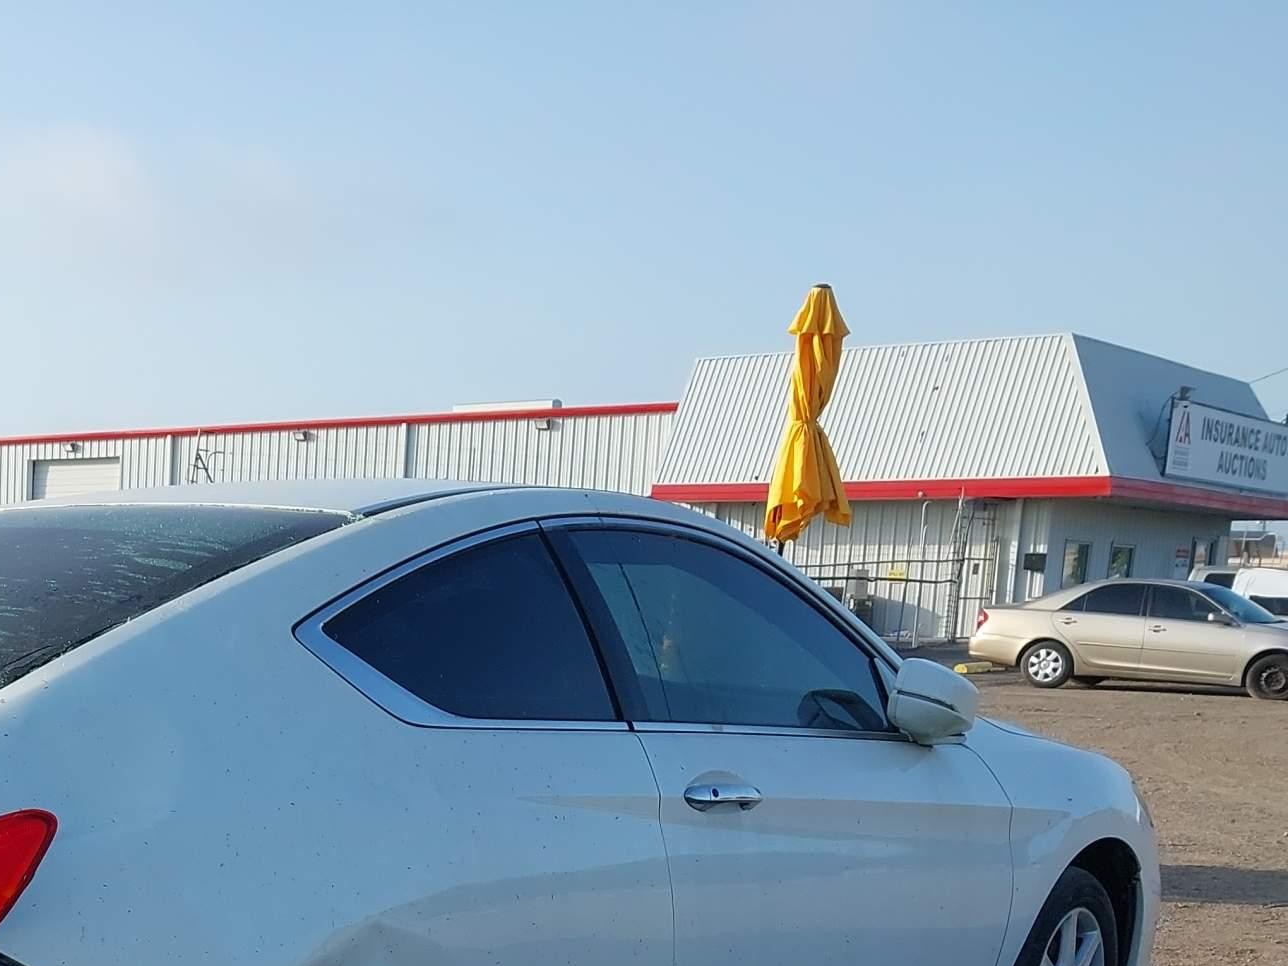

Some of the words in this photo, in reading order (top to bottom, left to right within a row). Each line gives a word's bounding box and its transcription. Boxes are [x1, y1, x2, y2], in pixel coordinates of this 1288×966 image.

[1200, 415, 1261, 452] INSURANCE
[1262, 431, 1288, 457] AUTO
[1216, 450, 1268, 481] AUCTIONS
